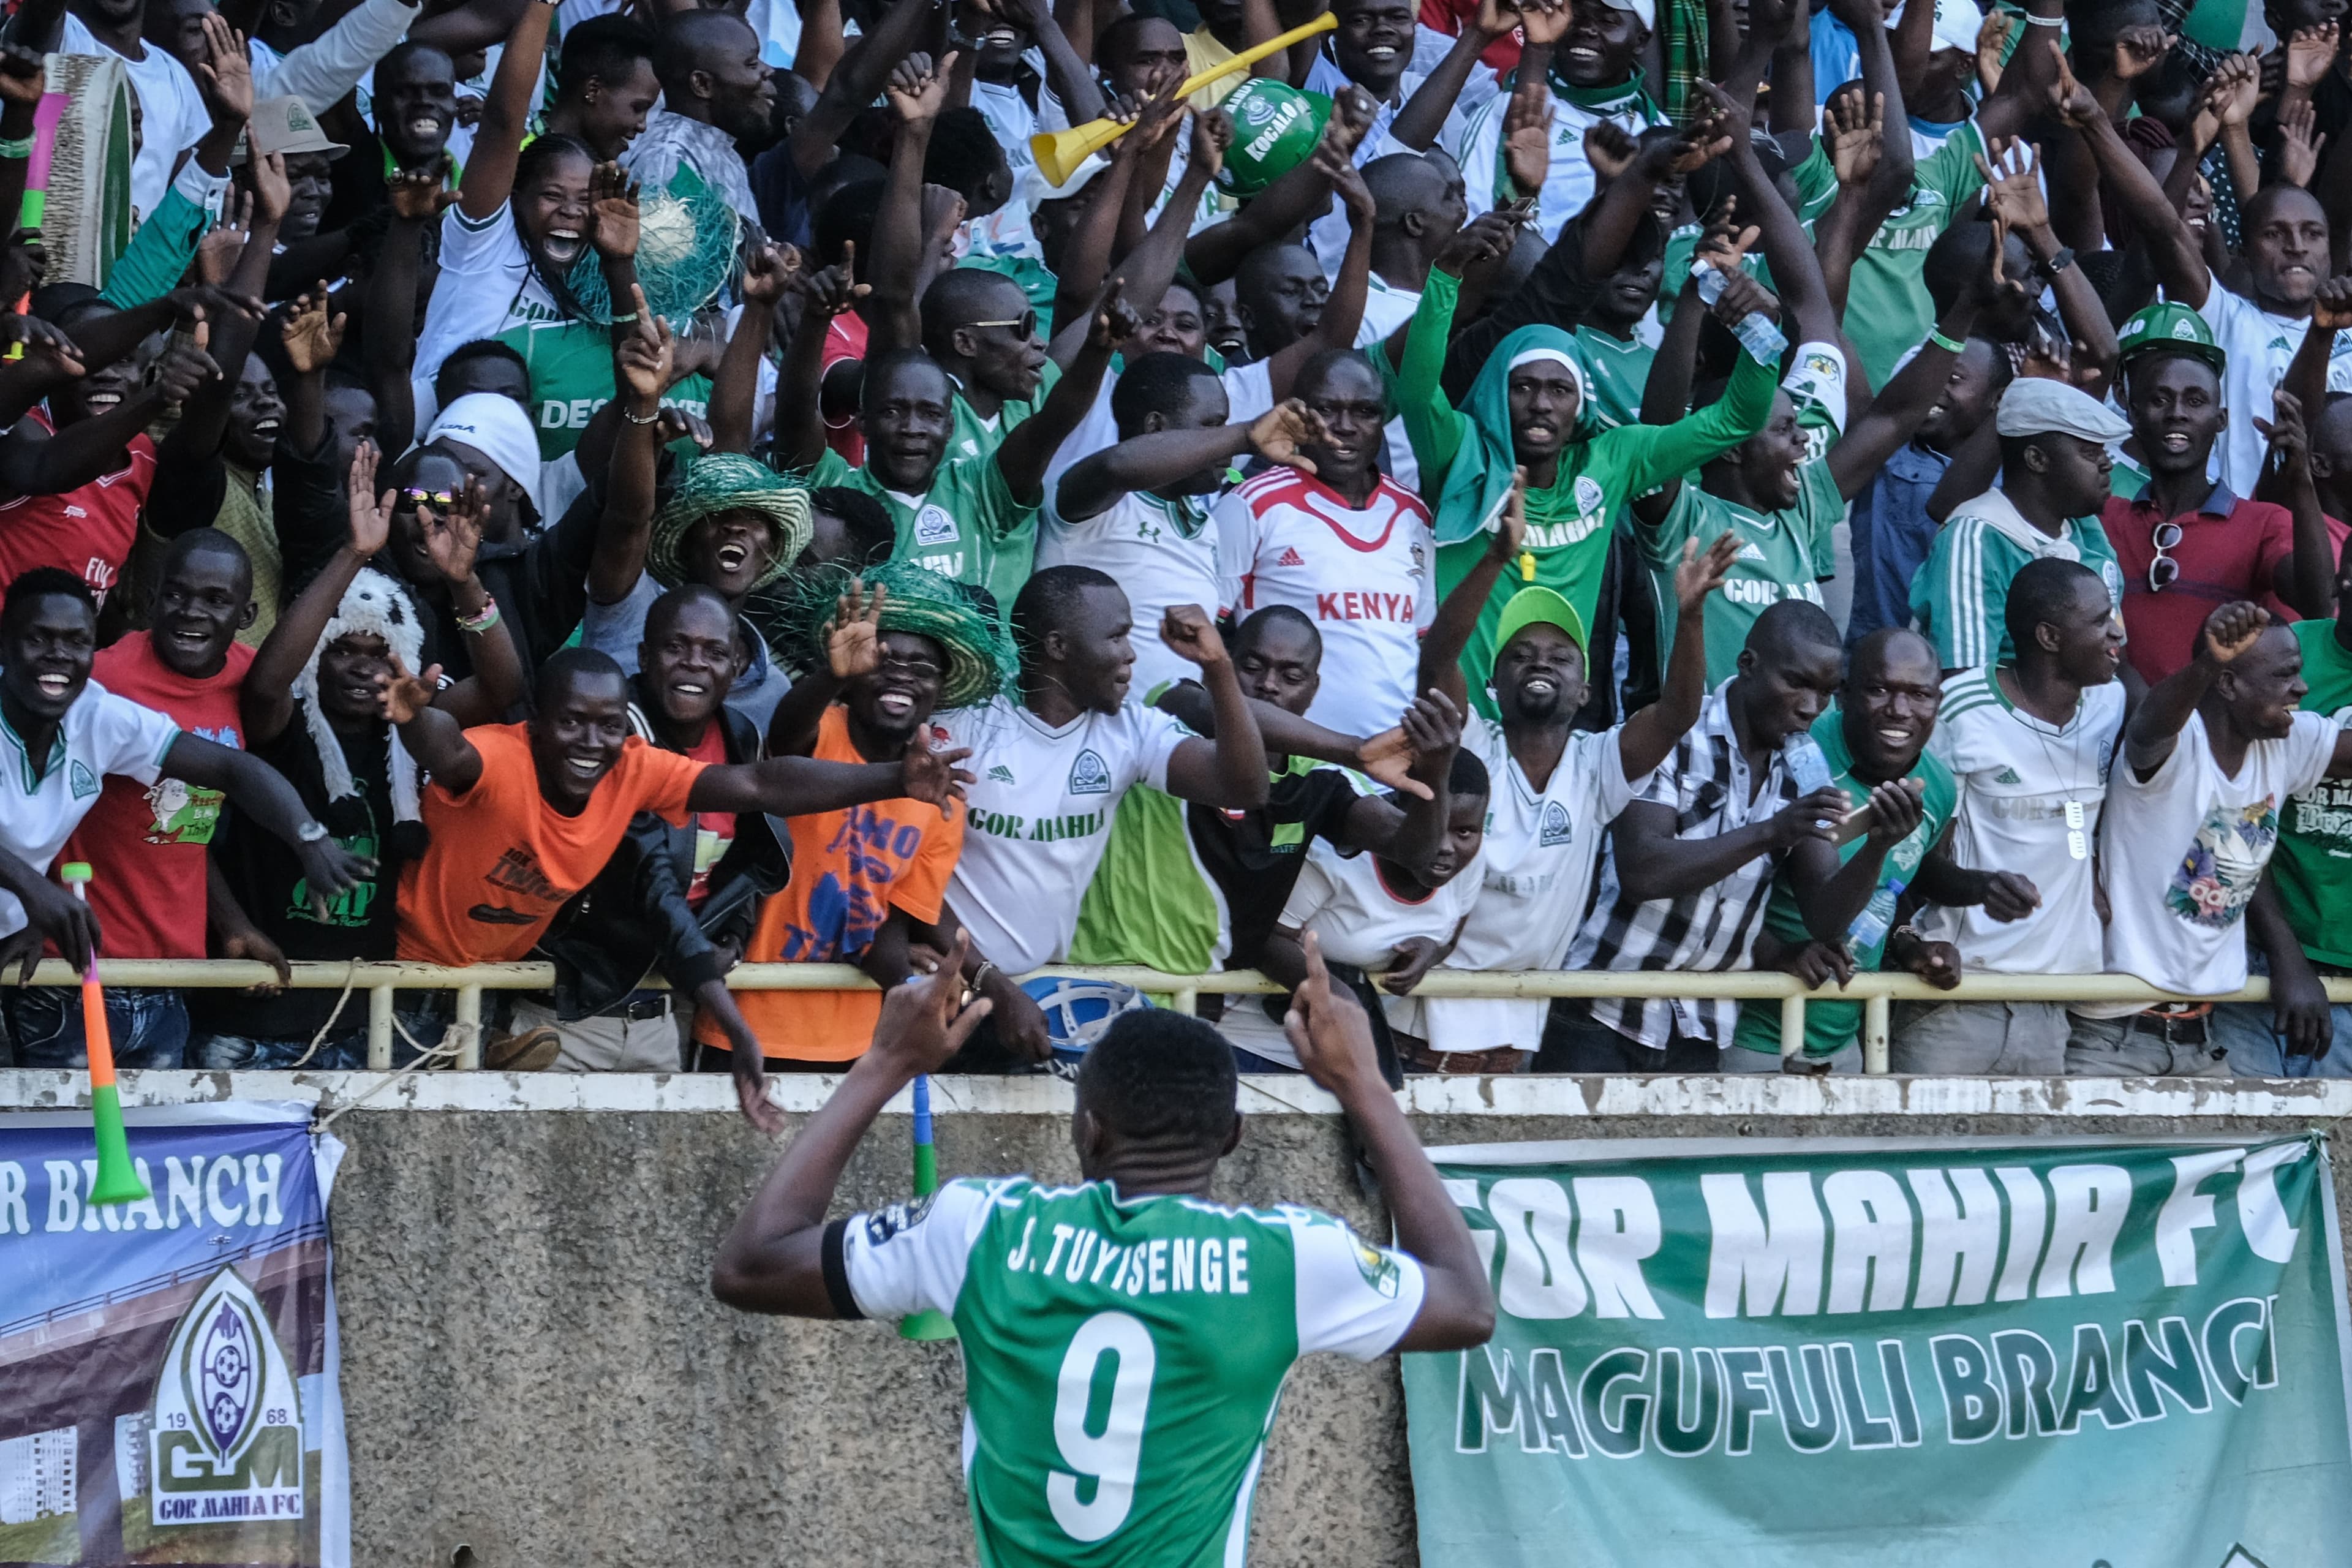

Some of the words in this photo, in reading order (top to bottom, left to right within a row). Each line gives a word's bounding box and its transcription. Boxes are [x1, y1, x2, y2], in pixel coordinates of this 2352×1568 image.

[1724, 578, 1779, 605] GOR
[1317, 592, 1414, 624] KENYA
[968, 807, 1024, 840] GOR
[1992, 797, 2046, 820] GOR
[1007, 1216, 1036, 1273] J.
[1043, 1223, 1249, 1297] TUYISENGE
[1700, 1164, 2133, 1319] MAHIA
[1455, 1339, 1923, 1460] MAGUFULI
[167, 1412, 186, 1428] 19
[266, 1409, 287, 1425] 68
[1046, 1310, 1156, 1542] 9
[159, 1498, 197, 1520] GOR
[200, 1495, 267, 1518] MAHIA
[272, 1494, 300, 1515] FC
